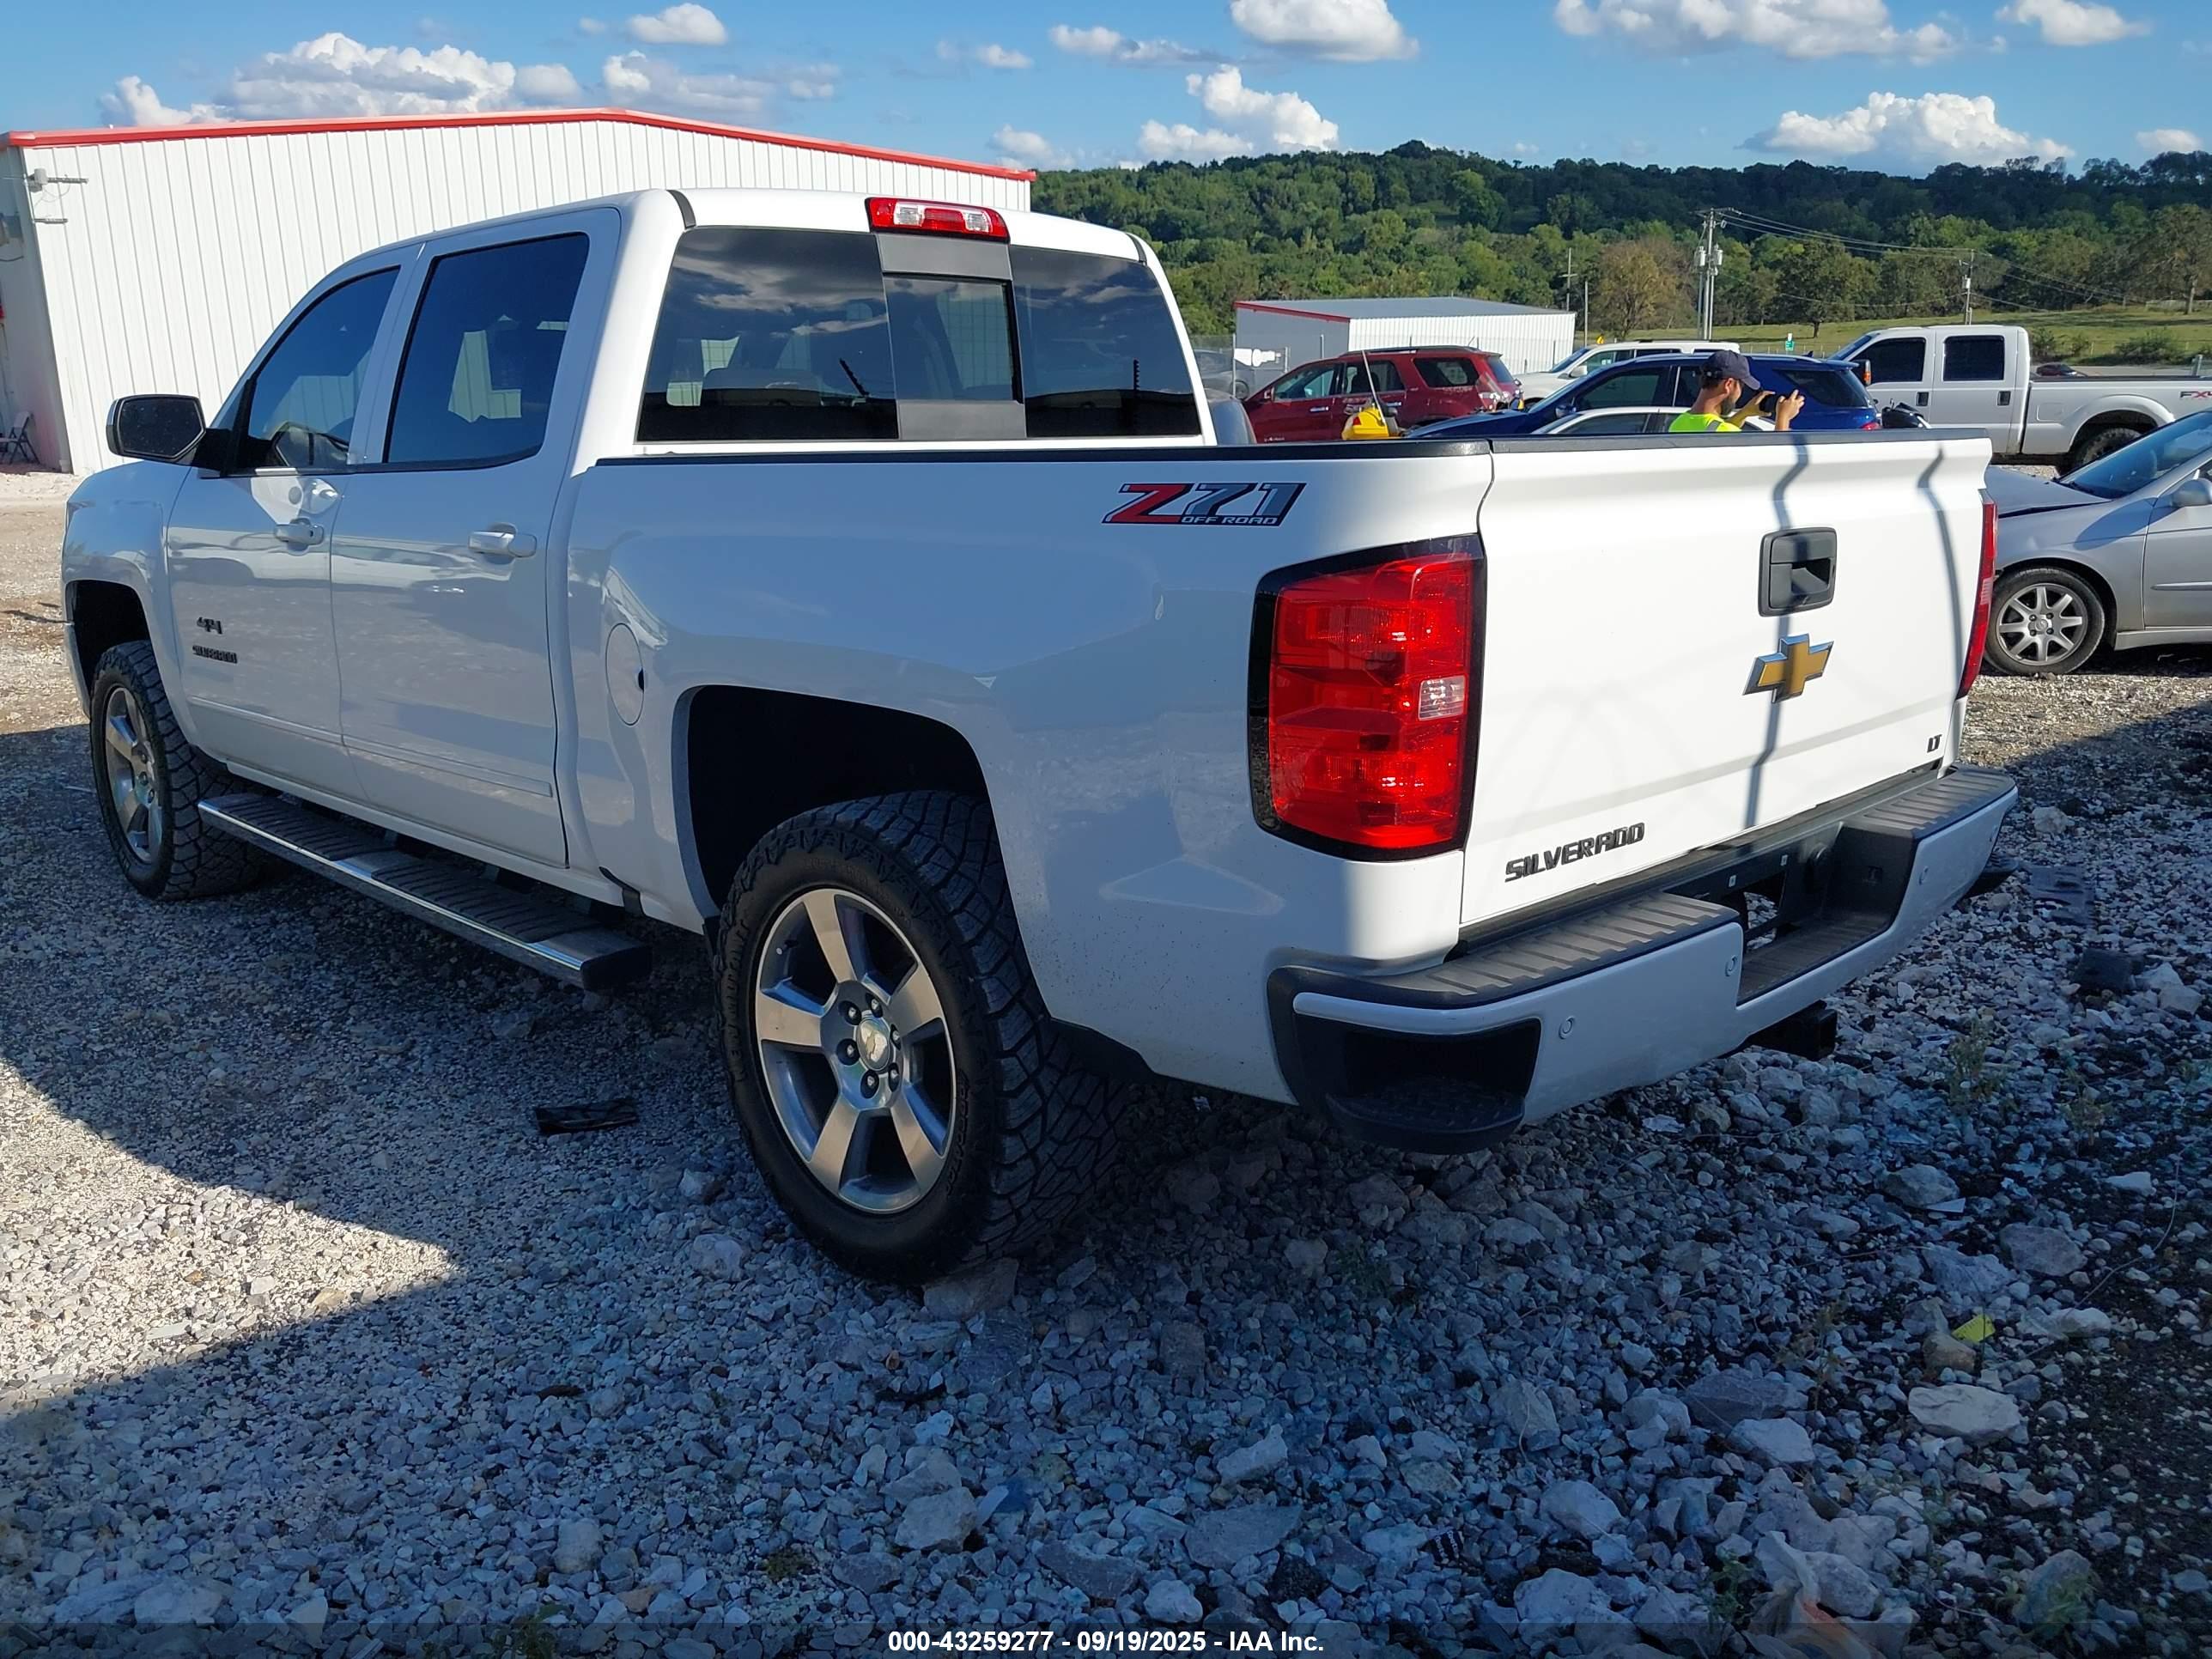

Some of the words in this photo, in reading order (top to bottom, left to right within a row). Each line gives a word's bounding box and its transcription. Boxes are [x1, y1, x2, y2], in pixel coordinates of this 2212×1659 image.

[1102, 483, 1306, 525] Z71
[1221, 516, 1278, 525] ROAD
[1926, 733, 1942, 753] LT
[1504, 823, 1645, 883] SILVERADO
